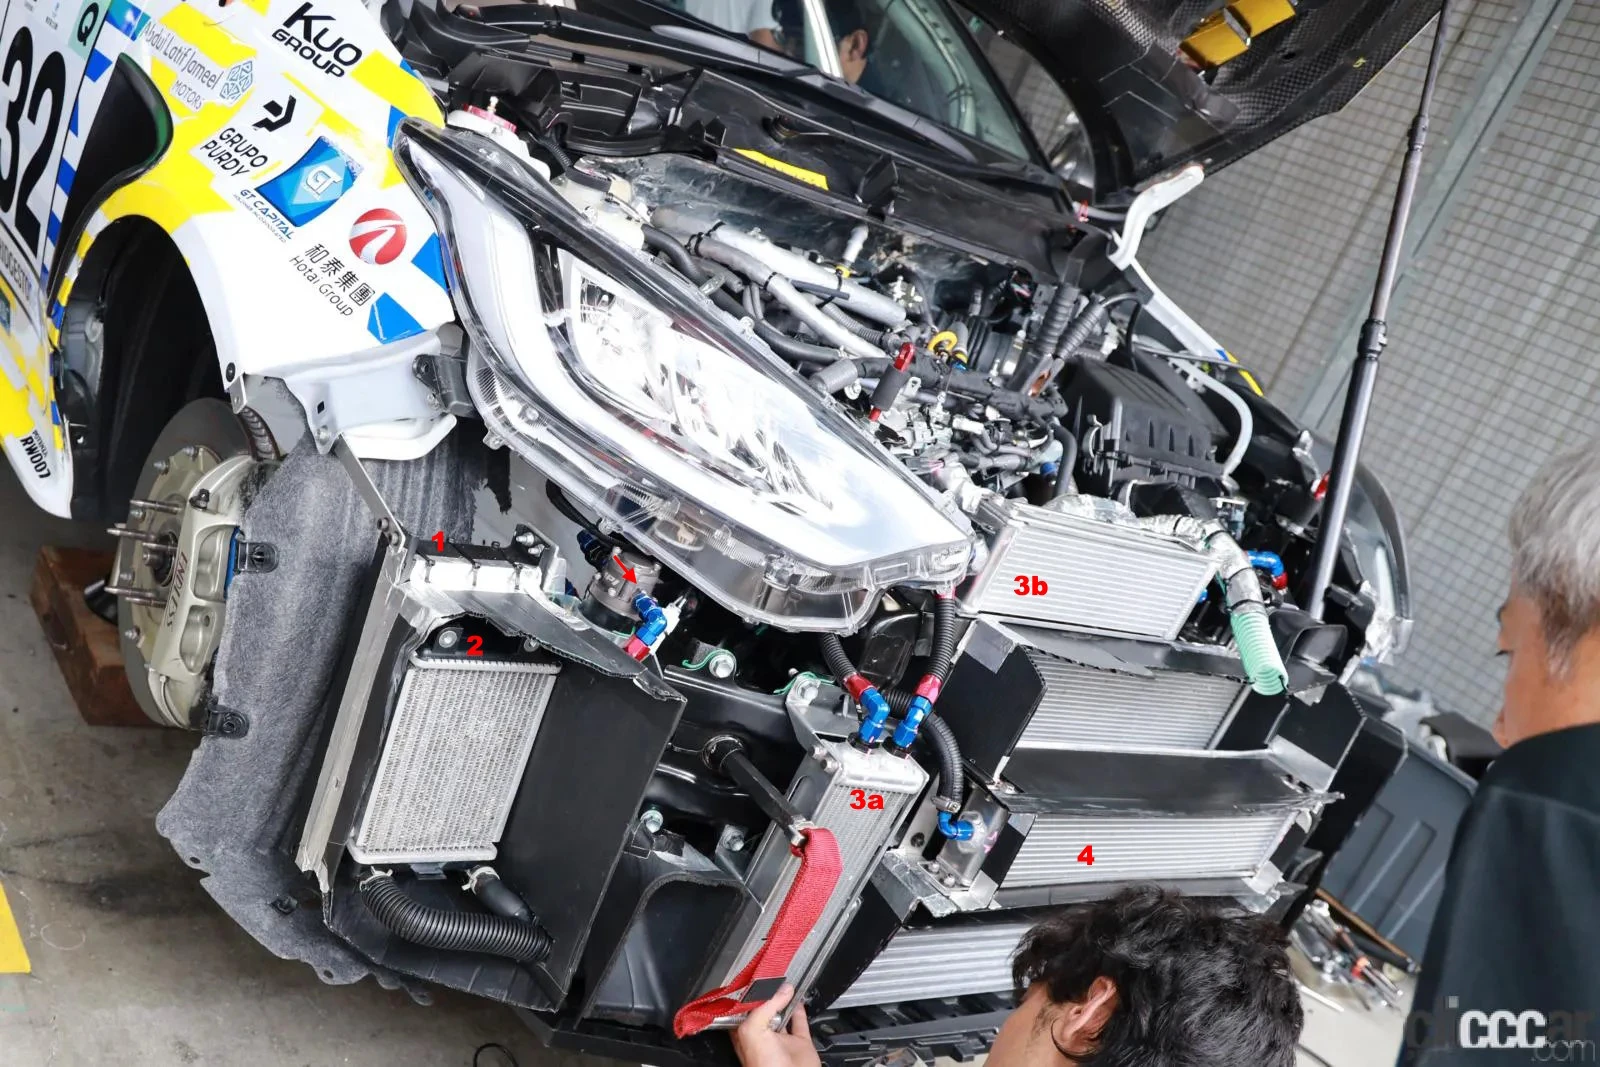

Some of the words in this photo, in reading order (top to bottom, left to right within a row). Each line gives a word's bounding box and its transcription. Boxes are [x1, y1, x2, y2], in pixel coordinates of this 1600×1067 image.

[77, 2, 99, 46] Q
[282, 1, 363, 66] KUO
[142, 21, 170, 51] Abdul
[164, 36, 192, 65] Latif
[181, 51, 224, 90] Jameel
[271, 28, 345, 77] GROUP
[171, 80, 203, 110] MOTORS
[0, 26, 66, 259] 32
[200, 140, 249, 176] PURDY
[218, 127, 268, 168] GRUPO
[240, 189, 256, 199] GT
[253, 201, 295, 239] CAPITAL
[288, 255, 322, 285] Hotai
[318, 283, 354, 316] Group
[304, 243, 376, 306] 和泰集團
[20, 435, 51, 478] RW007
